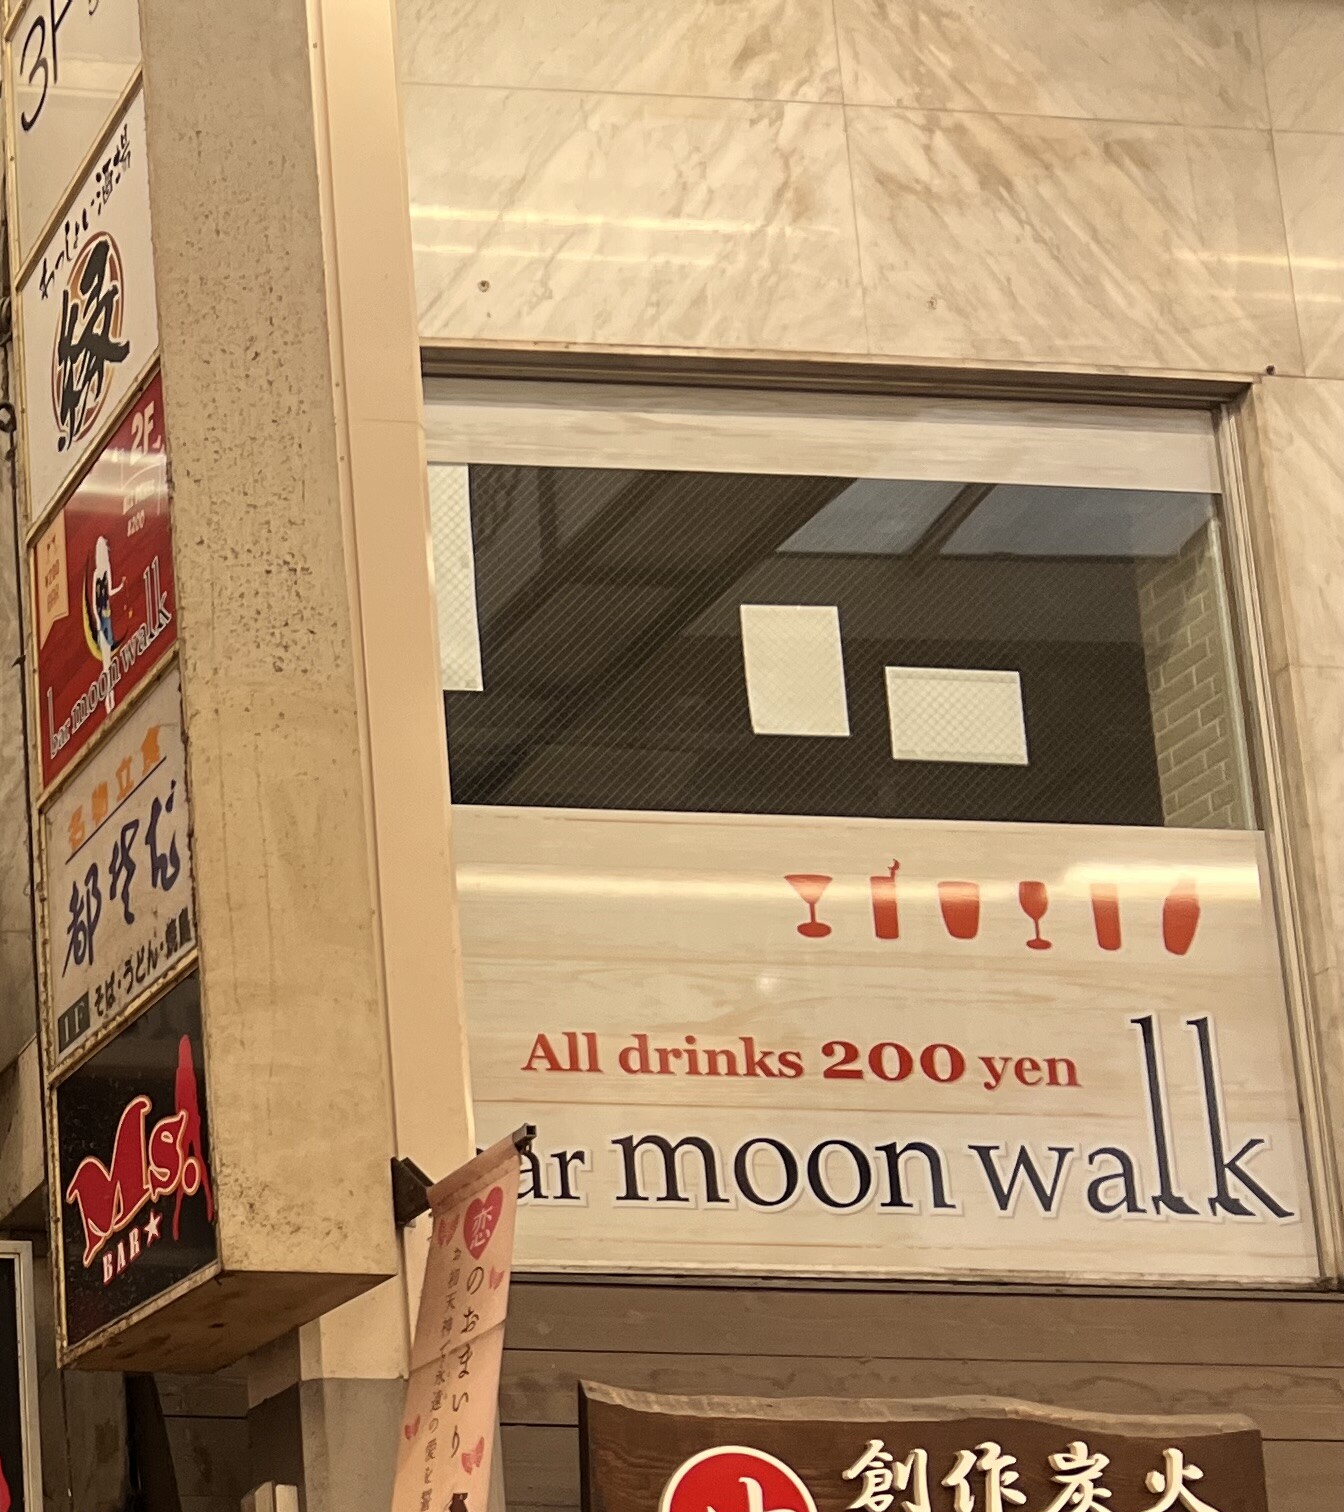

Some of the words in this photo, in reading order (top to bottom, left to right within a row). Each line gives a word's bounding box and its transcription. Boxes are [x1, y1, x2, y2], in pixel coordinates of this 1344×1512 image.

[131, 403, 156, 467] 2F
[521, 1033, 600, 1075] All
[619, 1035, 804, 1079] drinks
[821, 1041, 966, 1084] 200
[979, 1053, 1082, 1090] yen
[476, 1146, 587, 1202] ar
[612, 1133, 948, 1210] moon
[968, 1013, 1295, 1217] walk
[103, 1230, 141, 1285] BAR
